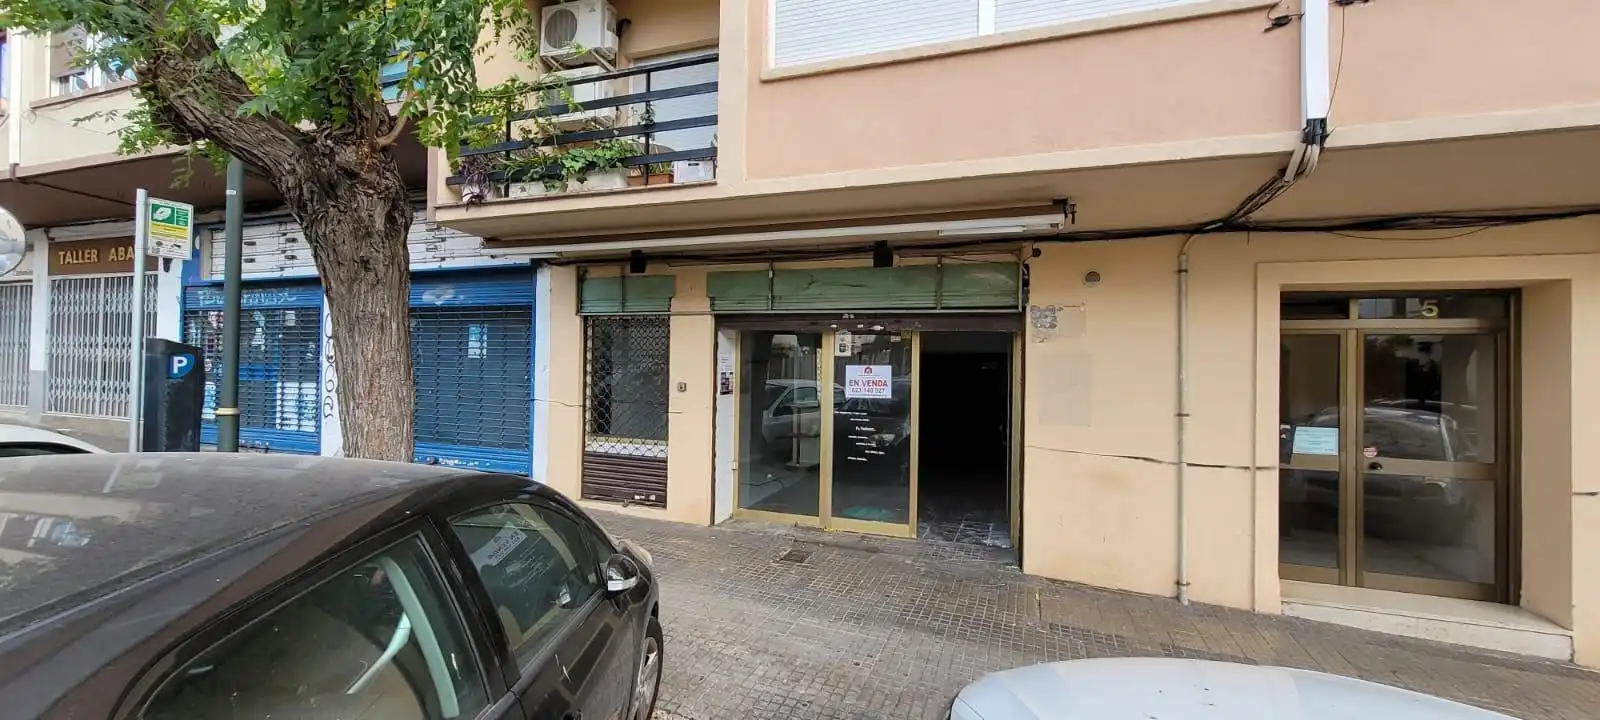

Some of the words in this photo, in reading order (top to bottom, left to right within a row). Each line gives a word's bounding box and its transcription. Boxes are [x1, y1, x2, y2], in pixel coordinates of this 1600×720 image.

[58, 249, 98, 265] TALLER
[109, 245, 135, 261] ABA
[1422, 299, 1439, 317] 5
[173, 356, 188, 374] P
[848, 380, 860, 388] EN
[861, 380, 888, 388] VENDA
